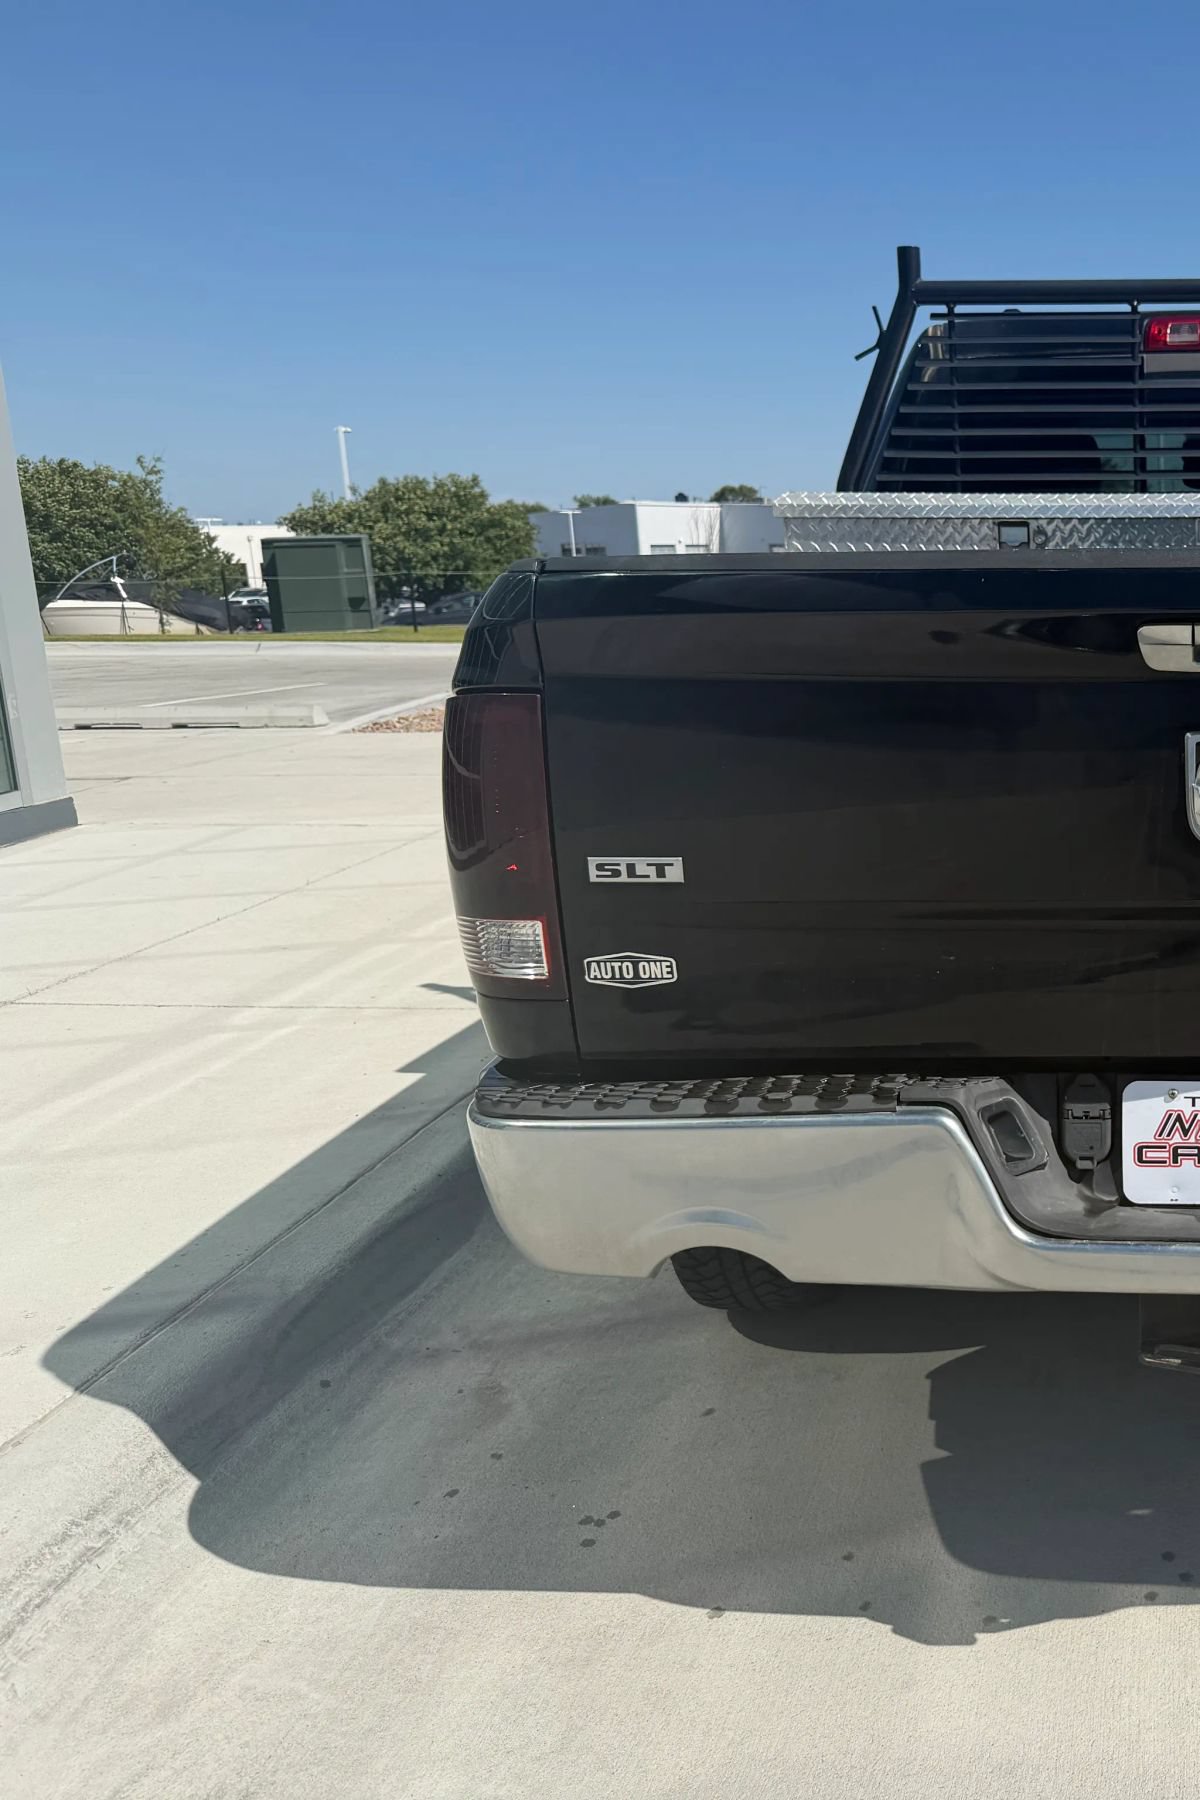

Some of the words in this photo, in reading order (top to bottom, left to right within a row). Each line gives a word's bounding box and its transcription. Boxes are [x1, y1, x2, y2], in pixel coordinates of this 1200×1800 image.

[595, 862, 675, 879] SLT
[590, 961, 634, 979] AUTO
[638, 961, 673, 979] ONE
